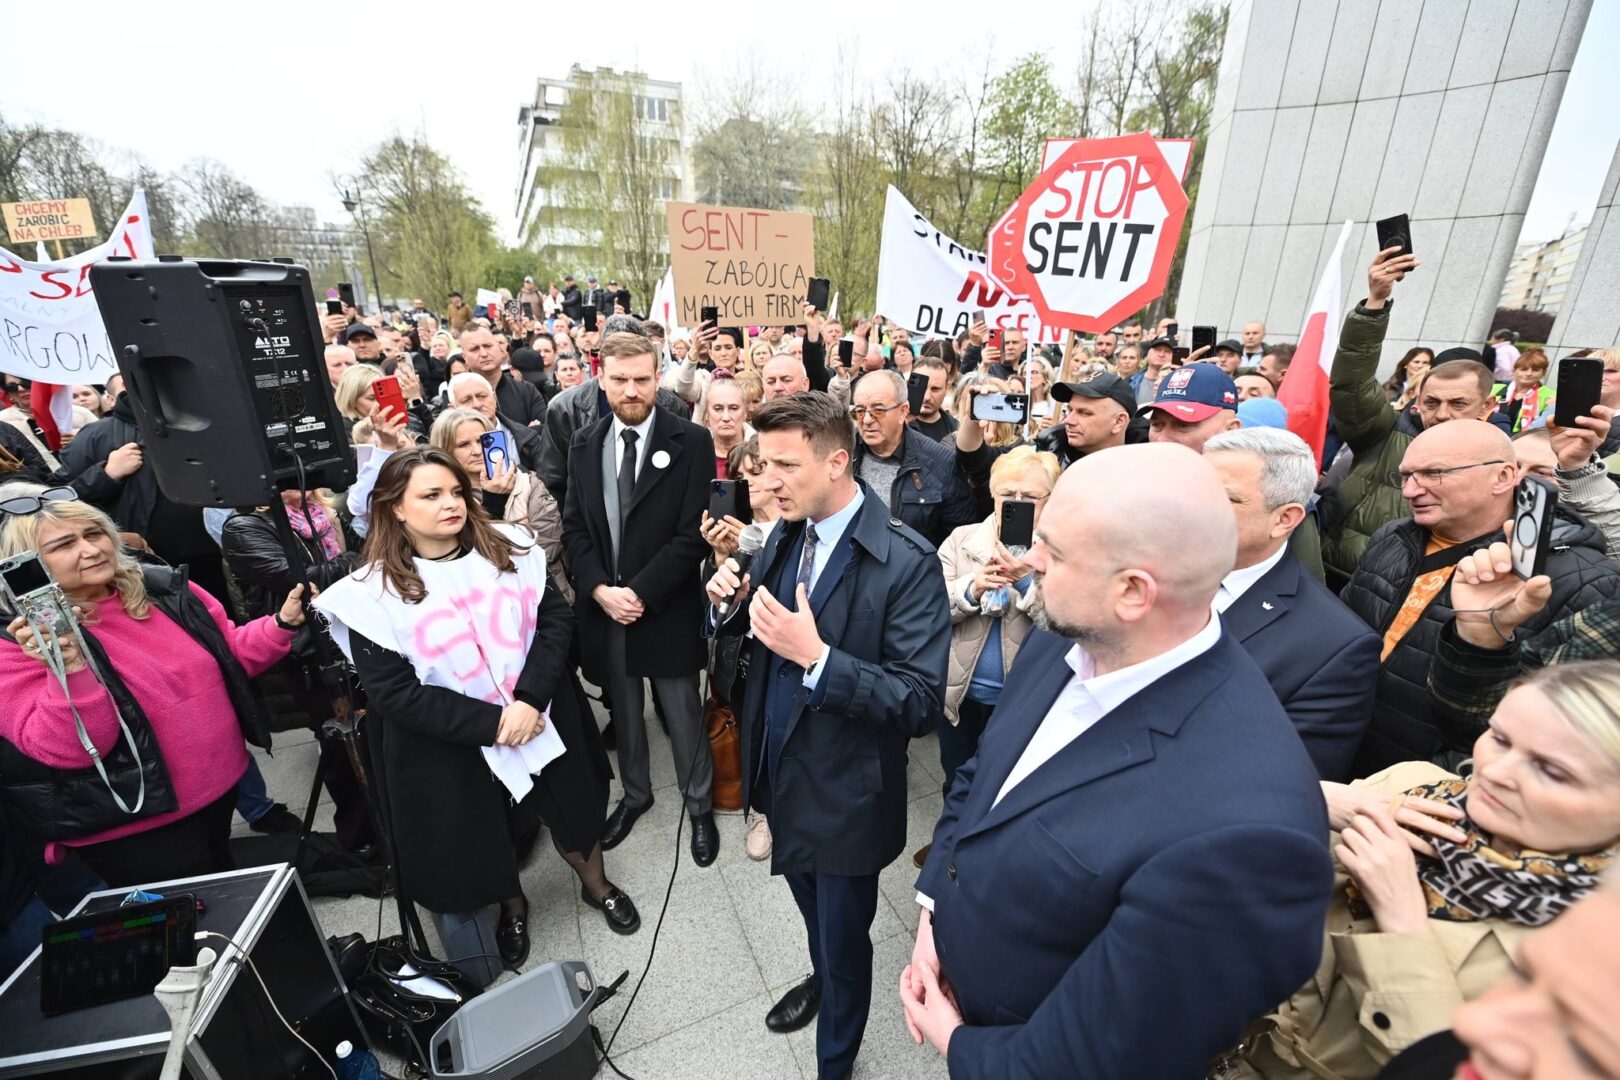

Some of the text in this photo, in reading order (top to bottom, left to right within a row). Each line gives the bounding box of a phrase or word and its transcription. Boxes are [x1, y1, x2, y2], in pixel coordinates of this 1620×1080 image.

[1044, 157, 1163, 221] STOP
[15, 201, 67, 216] CHCEMY
[14, 224, 83, 241] NA CHLEB
[681, 209, 770, 251] SENT
[1026, 221, 1155, 282] SENT
[705, 256, 807, 289] ZABÓJCA
[916, 304, 970, 338] DLA
[254, 336, 291, 346] ALTO
[1162, 388, 1187, 397] POLSKA
